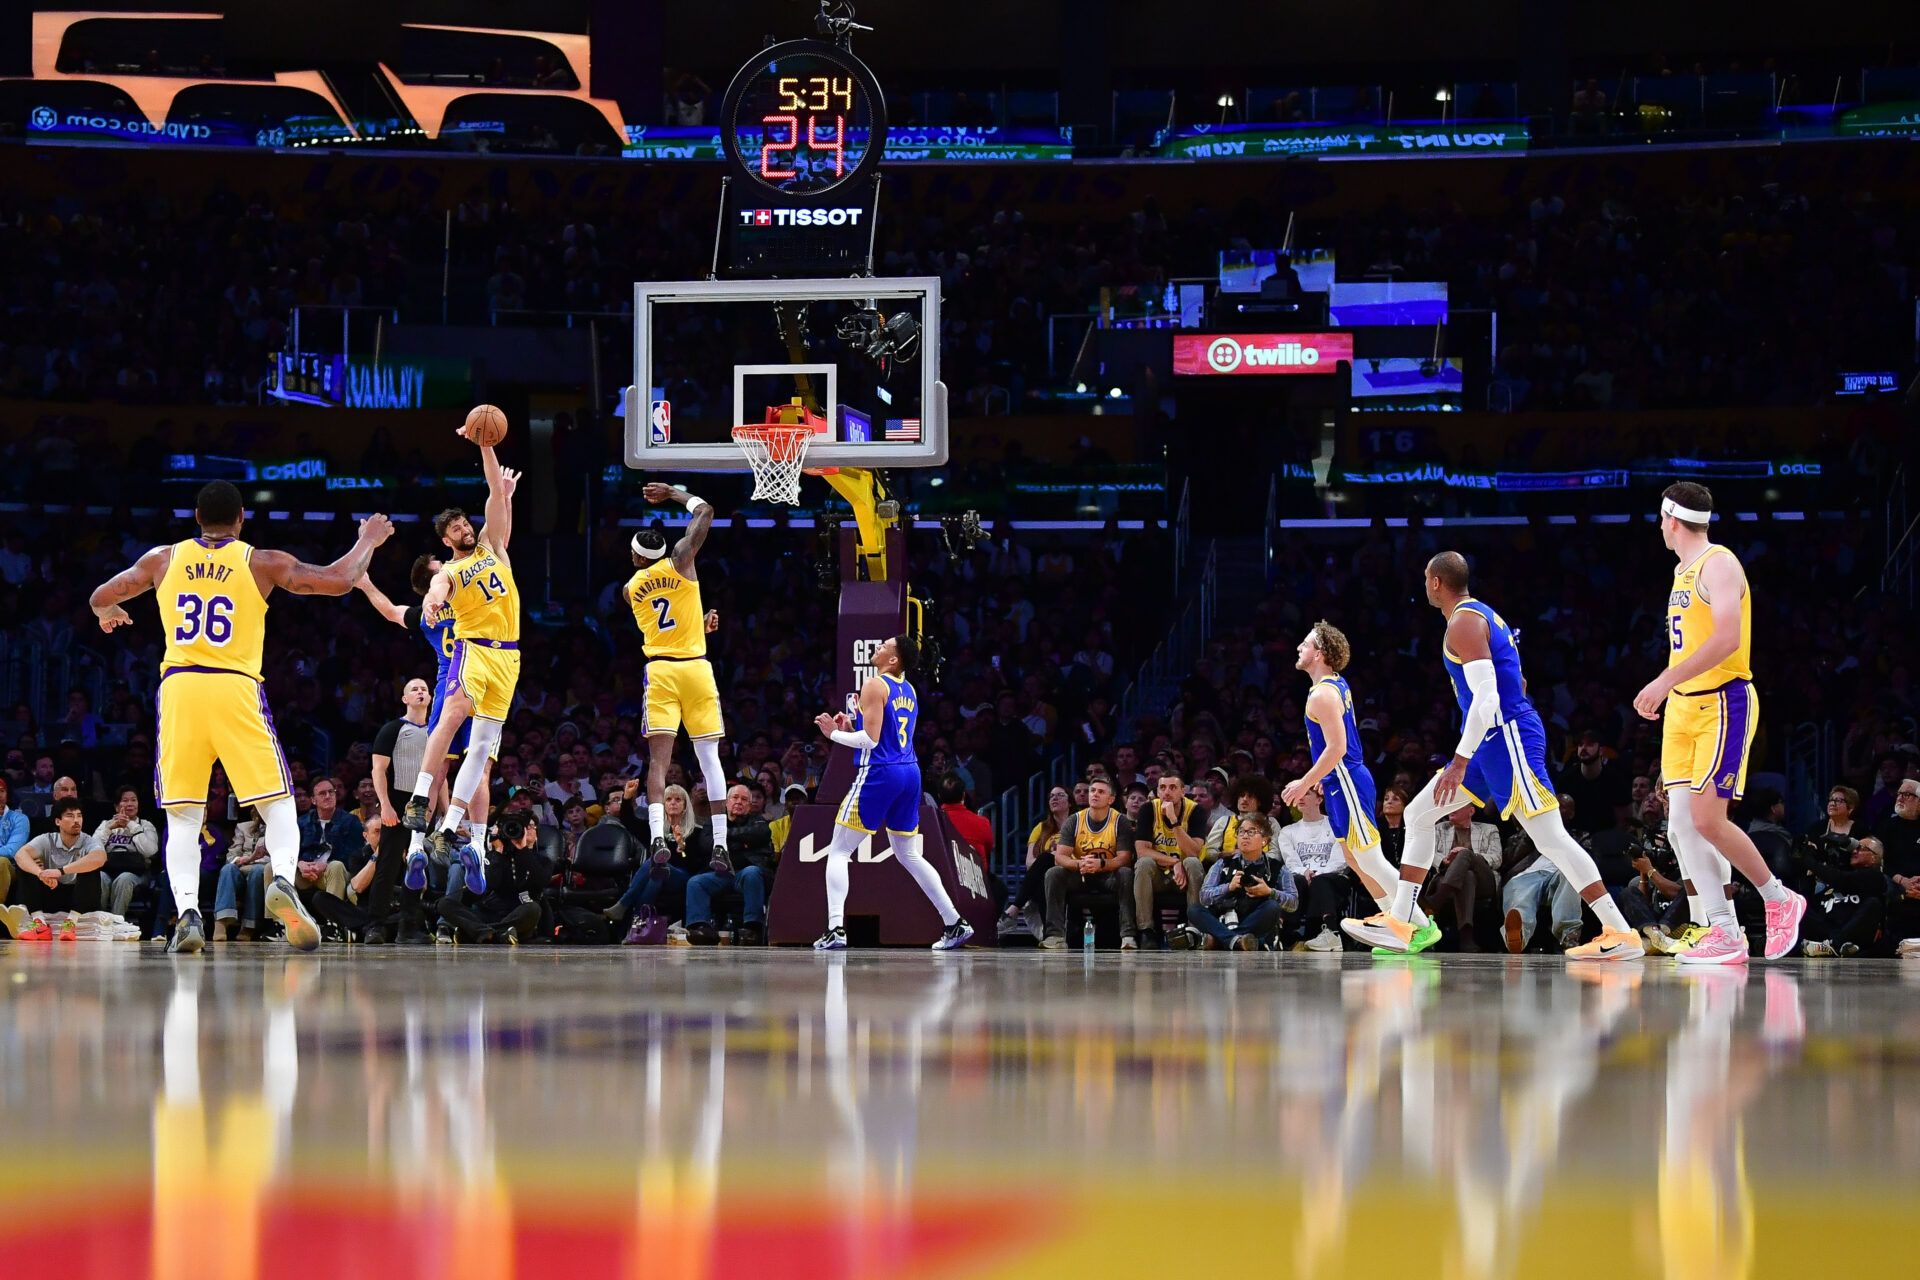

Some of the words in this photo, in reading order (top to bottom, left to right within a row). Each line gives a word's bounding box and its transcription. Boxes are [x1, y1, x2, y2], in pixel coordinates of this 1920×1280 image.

[778, 77, 852, 111] 5:34
[762, 115, 844, 178] 24
[773, 208, 863, 226] TISSOT
[1243, 343, 1319, 366] twilio
[185, 562, 234, 584] SMART
[459, 555, 497, 588] LAKERS
[476, 571, 508, 604] 14
[633, 577, 682, 604] VANDERBILT
[175, 592, 235, 648] 36
[651, 597, 678, 632] 2
[853, 666, 880, 691] TH
[897, 716, 909, 748] 3
